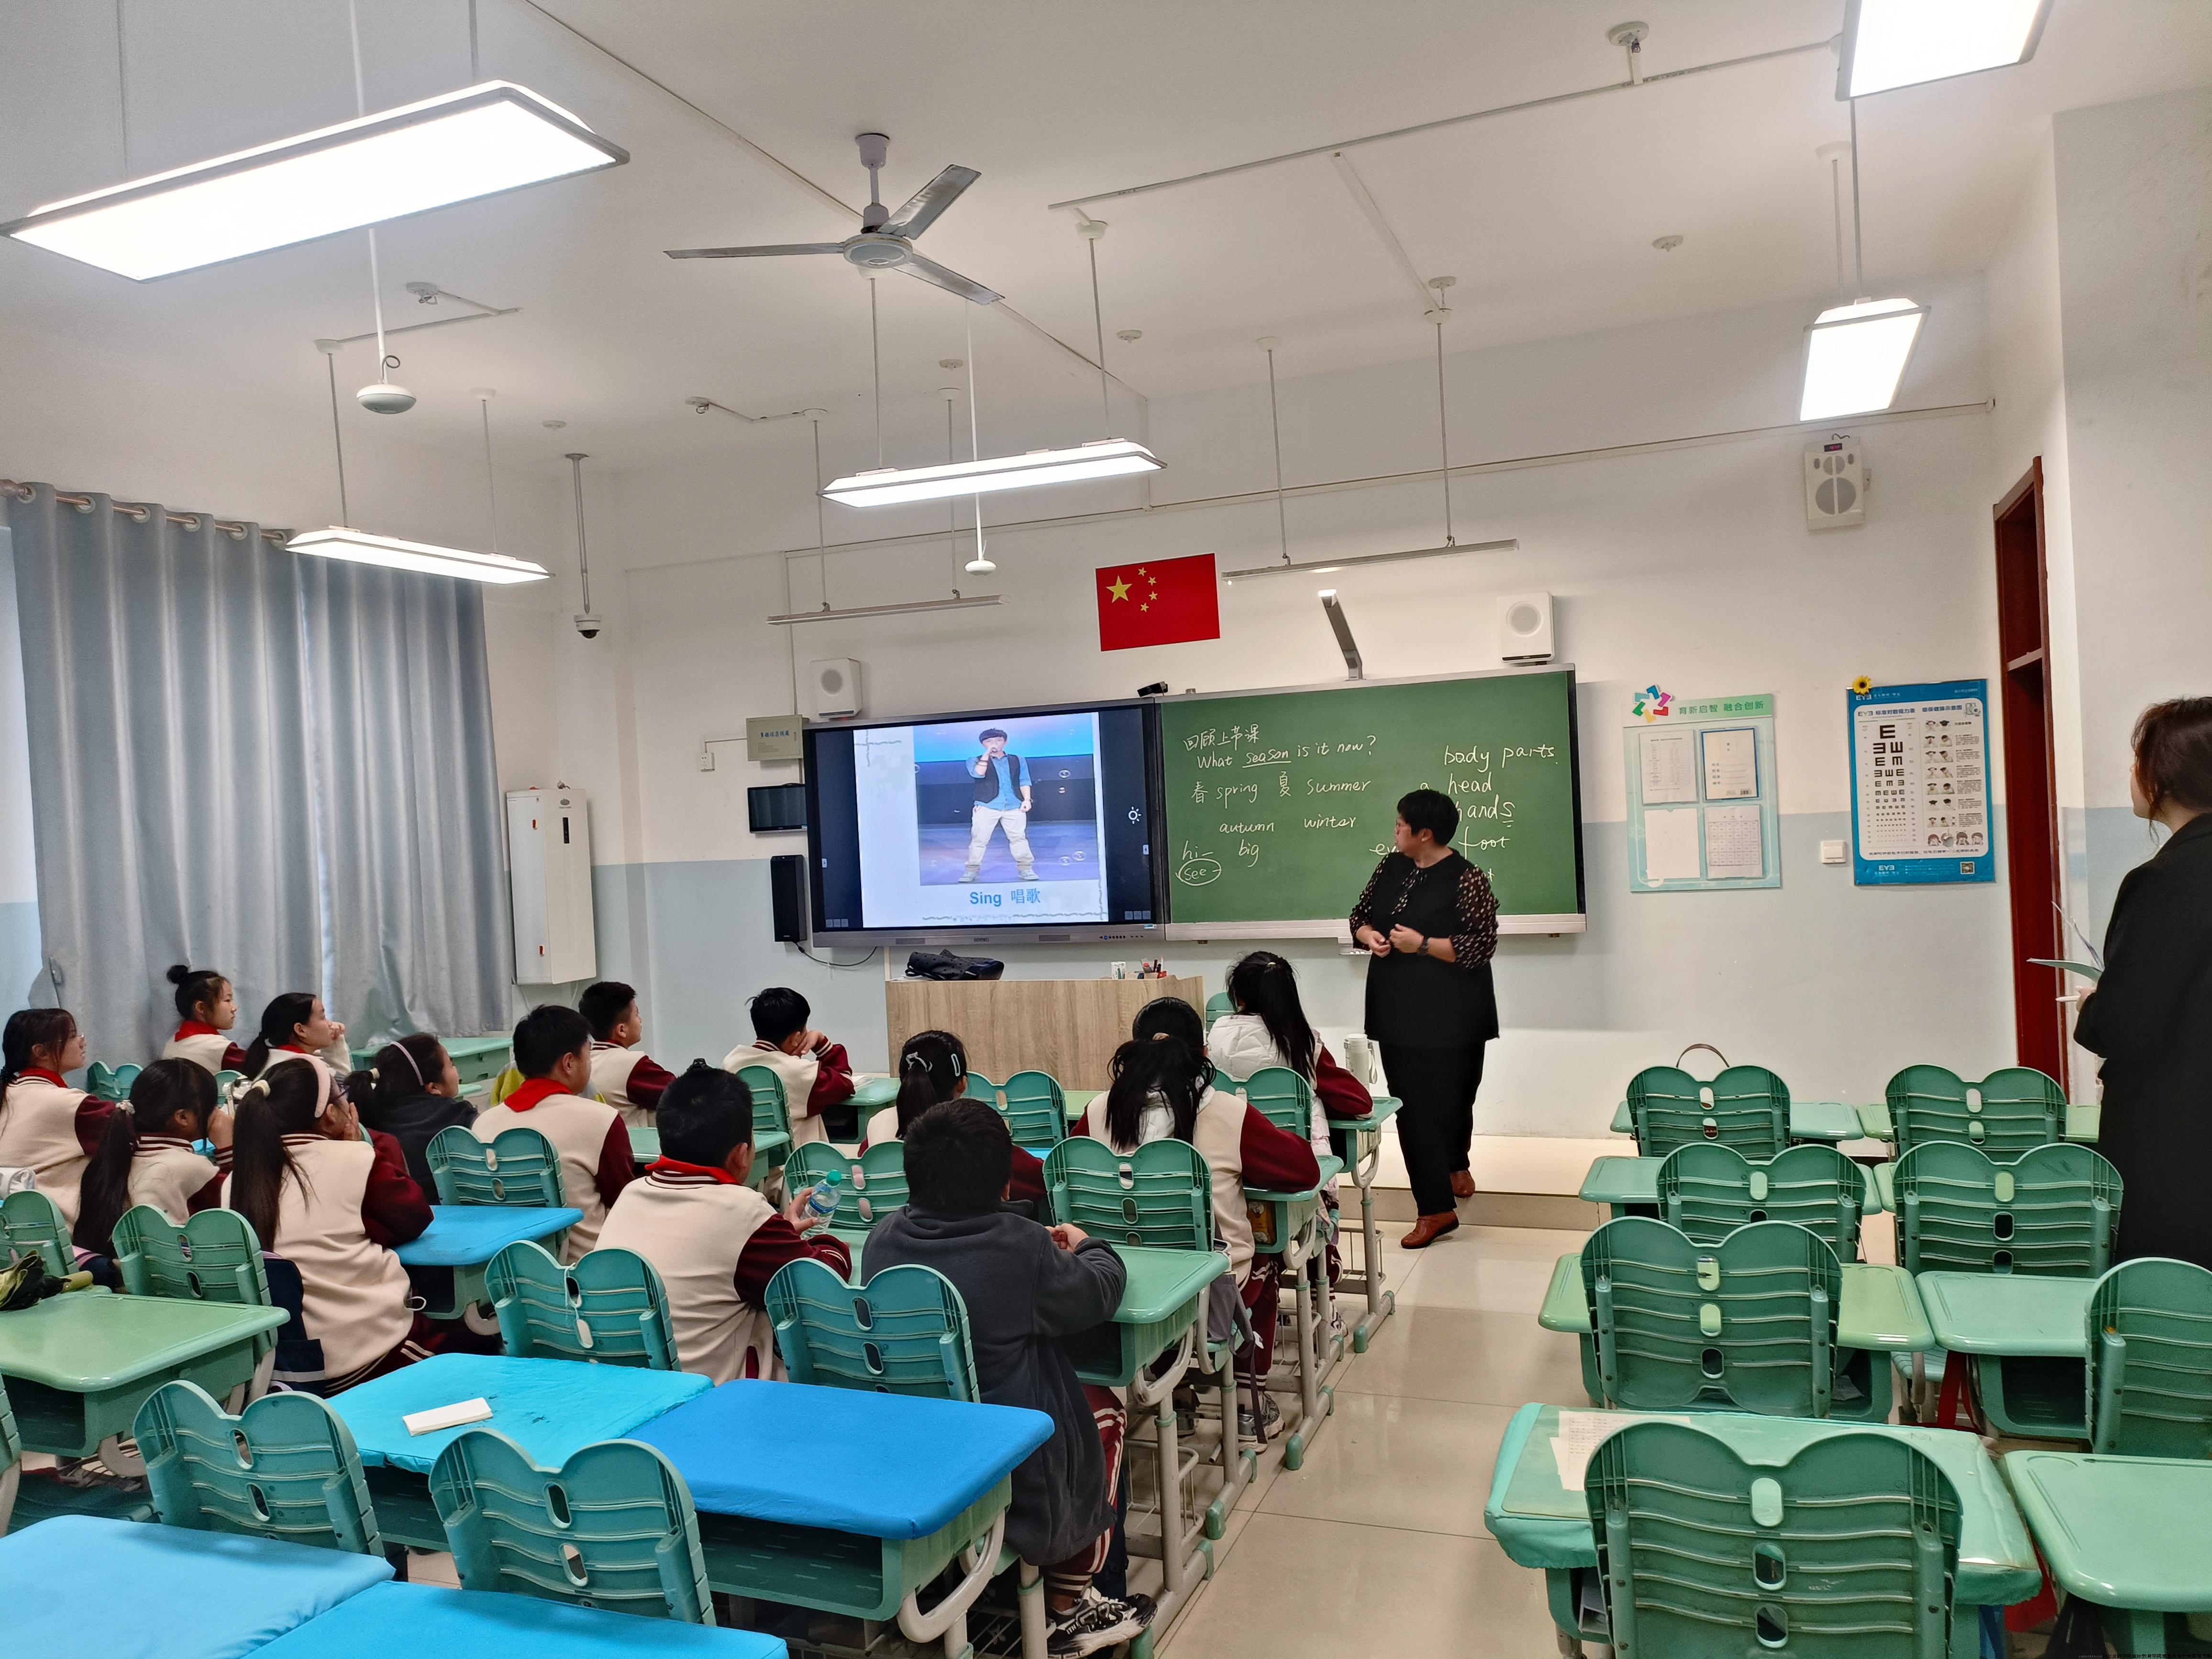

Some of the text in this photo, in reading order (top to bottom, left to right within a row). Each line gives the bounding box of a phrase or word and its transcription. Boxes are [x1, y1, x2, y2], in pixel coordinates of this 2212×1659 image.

[1678, 701, 1764, 715] 育新启智 融合创新
[1183, 723, 1260, 751] 回顾上节课
[1197, 751, 1233, 769] What
[1297, 744, 1310, 757] is
[1315, 742, 1329, 755] it
[1444, 745, 1490, 773] body
[1191, 781, 1208, 803] 春
[1216, 783, 1258, 809] spring
[1279, 771, 1292, 797] 夏
[1448, 771, 1492, 795] head
[1456, 794, 1515, 822] hands
[1219, 822, 1274, 834] autumn
[1238, 839, 1260, 868] big
[1458, 826, 1510, 860] foot
[970, 888, 1041, 907] Sing 唱歌
